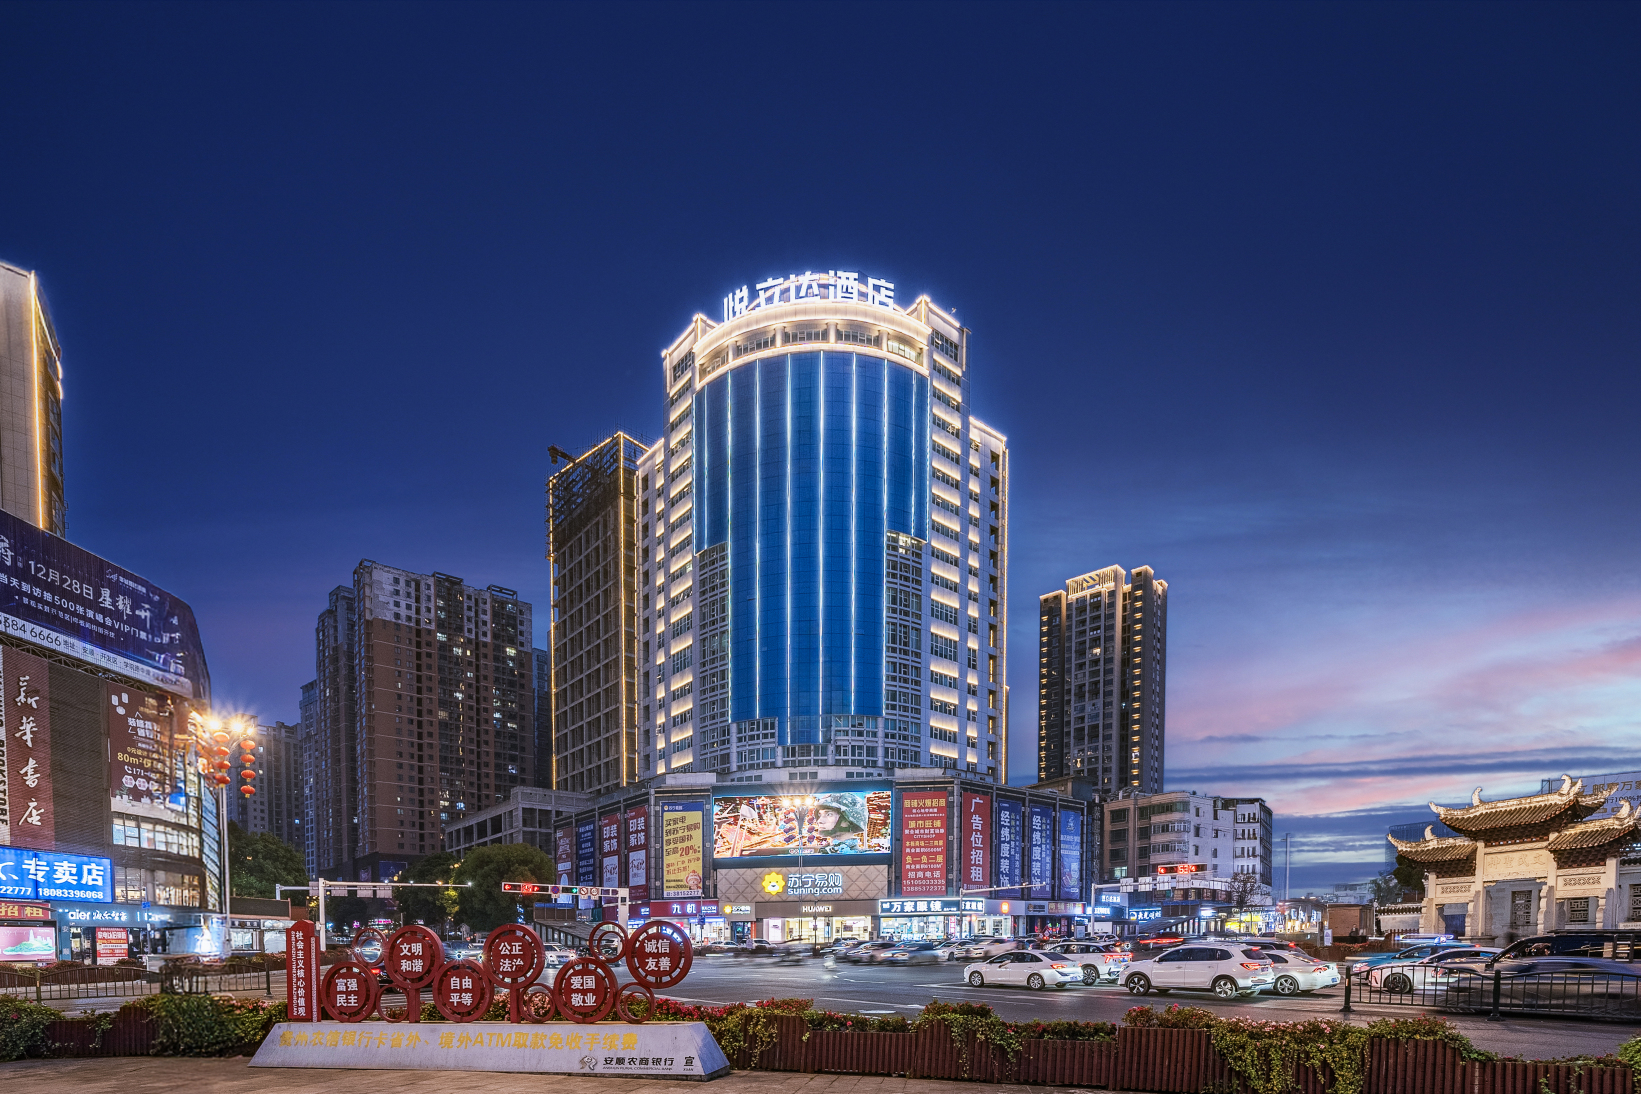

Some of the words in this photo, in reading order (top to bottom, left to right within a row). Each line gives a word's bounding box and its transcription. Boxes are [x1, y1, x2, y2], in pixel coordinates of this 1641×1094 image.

[970, 797, 984, 882] 广告位招租
[787, 873, 843, 888] 苏宁易购
[907, 871, 941, 879] 招商电话
[787, 886, 843, 896] suning.com
[672, 903, 697, 914] 九机
[802, 905, 832, 913] HUAWEI
[891, 901, 942, 912] 万家眼镜
[399, 943, 423, 956] 文明
[498, 942, 523, 955] 公正
[644, 939, 670, 954] 诚信
[400, 959, 424, 973] 和谐
[499, 959, 524, 972] 法治
[645, 958, 671, 971] 友善
[296, 930, 306, 1017] 社会主义核心价值观
[335, 978, 359, 991] 富强
[450, 976, 472, 989] 自由
[570, 975, 596, 989] 爱国
[336, 994, 359, 1007] 民主
[449, 992, 473, 1006] 平等
[571, 992, 596, 1007] 敬业
[602, 1056, 675, 1066] 安顺农商银行
[683, 1055, 695, 1067] 宣
